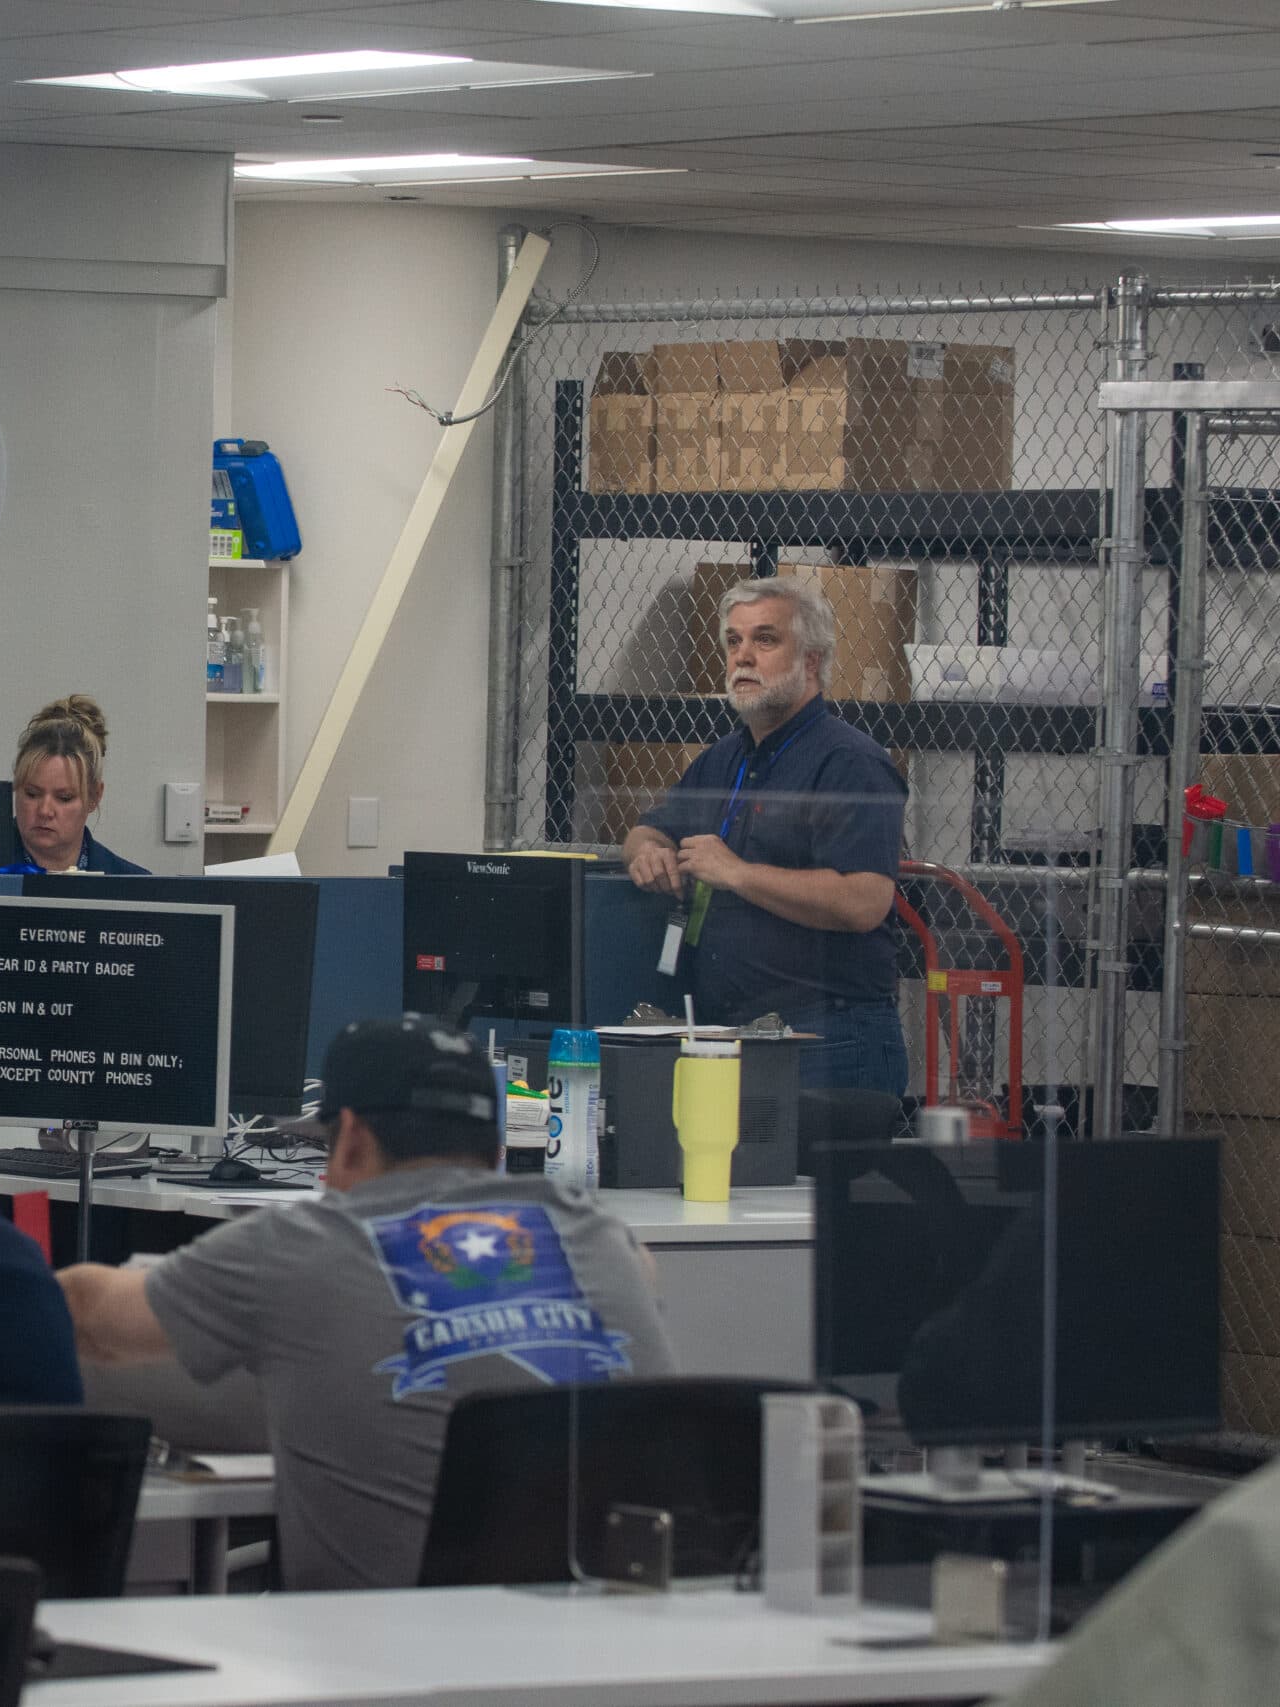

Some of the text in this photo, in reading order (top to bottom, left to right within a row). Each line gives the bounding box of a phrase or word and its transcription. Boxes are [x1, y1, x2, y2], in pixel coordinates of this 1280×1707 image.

[467, 861, 510, 875] ViewSonic
[20, 928, 164, 947] EVERYONE REQUIRED:
[24, 959, 35, 972] ID
[39, 960, 48, 973] &
[52, 960, 89, 974] PARTY
[95, 962, 135, 977] BADGE
[22, 1001, 34, 1014] IN
[37, 1002, 45, 1016] &
[51, 1003, 73, 1016] OUT
[51, 1049, 96, 1064] PHONES
[103, 1052, 115, 1065] IN
[120, 1053, 142, 1066] BIN
[48, 1069, 95, 1084] COUNTY
[106, 1072, 152, 1086] PHONES
[414, 1306, 527, 1350] CARSON
[532, 1303, 593, 1331] CITY
